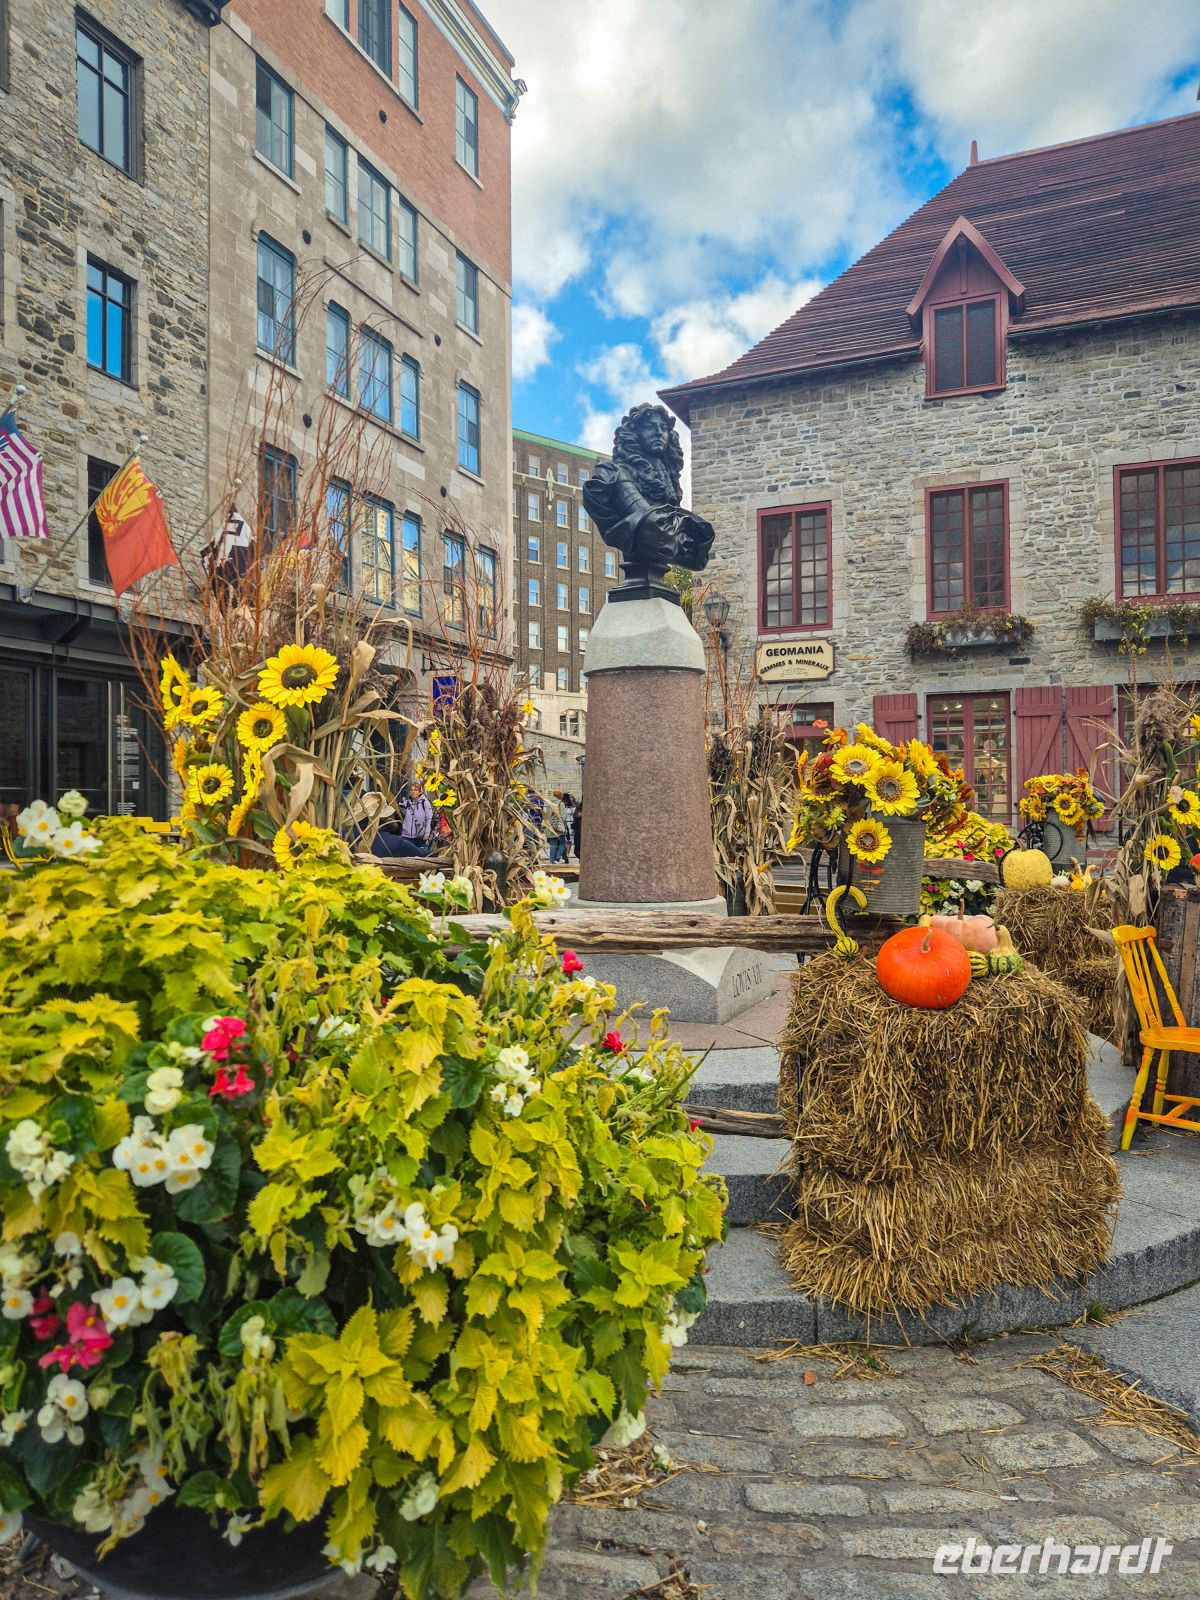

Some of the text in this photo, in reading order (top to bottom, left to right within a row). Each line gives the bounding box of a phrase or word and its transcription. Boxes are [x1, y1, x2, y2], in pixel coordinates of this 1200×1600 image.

[766, 646, 824, 657] GEOMANIA
[760, 661, 786, 674] GEMMES
[795, 659, 830, 671] MINERAUX
